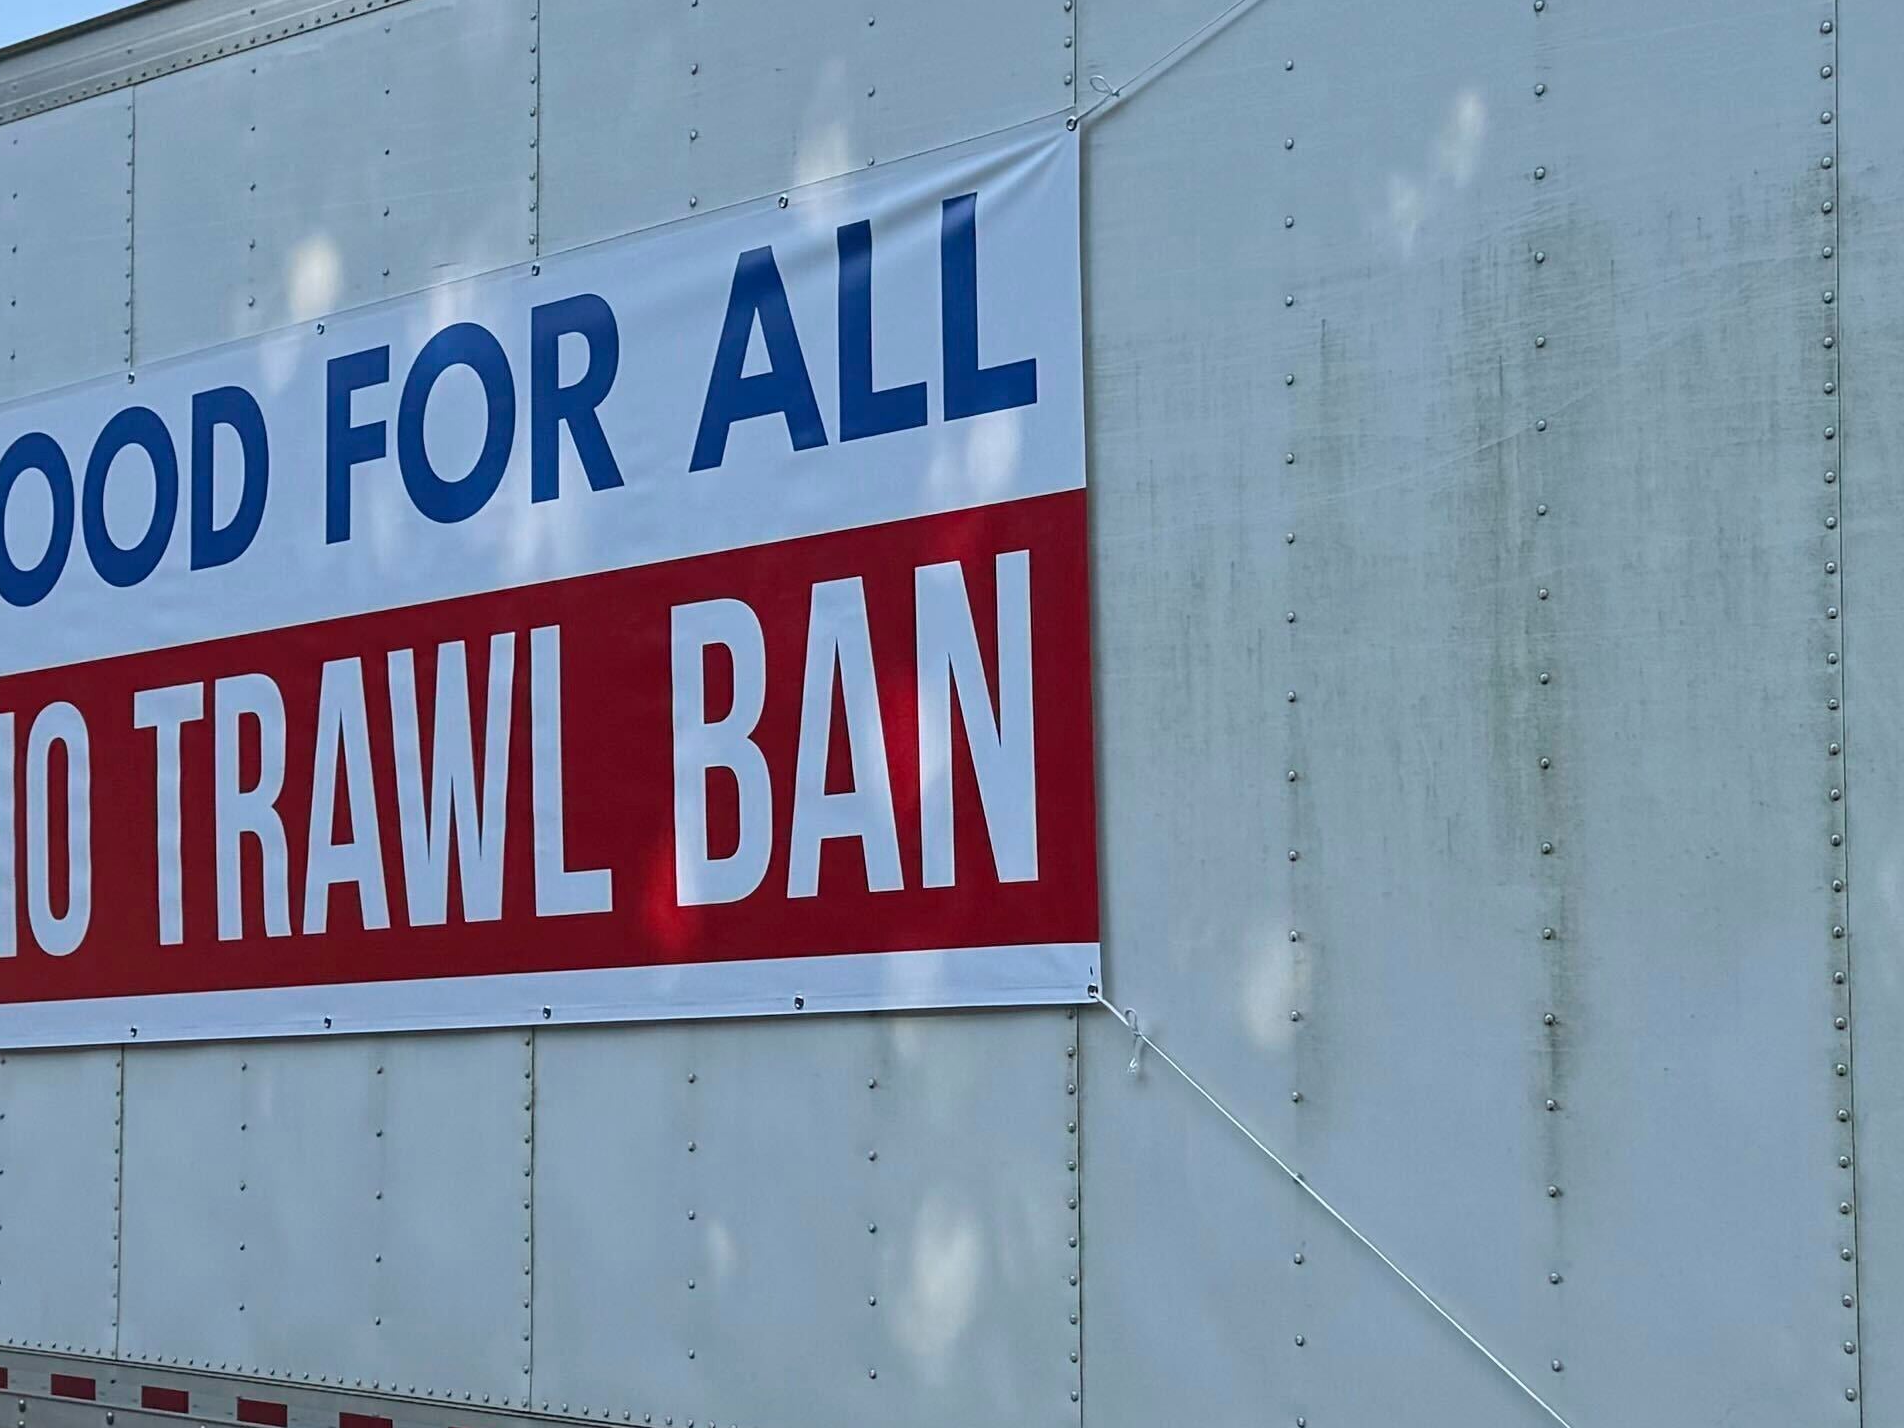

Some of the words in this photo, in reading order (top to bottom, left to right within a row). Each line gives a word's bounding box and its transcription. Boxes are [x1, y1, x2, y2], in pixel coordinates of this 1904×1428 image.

[325, 292, 626, 547] FOR
[687, 190, 1039, 474] ALL
[132, 624, 614, 948] TRAWL
[670, 549, 1040, 908] BAN
